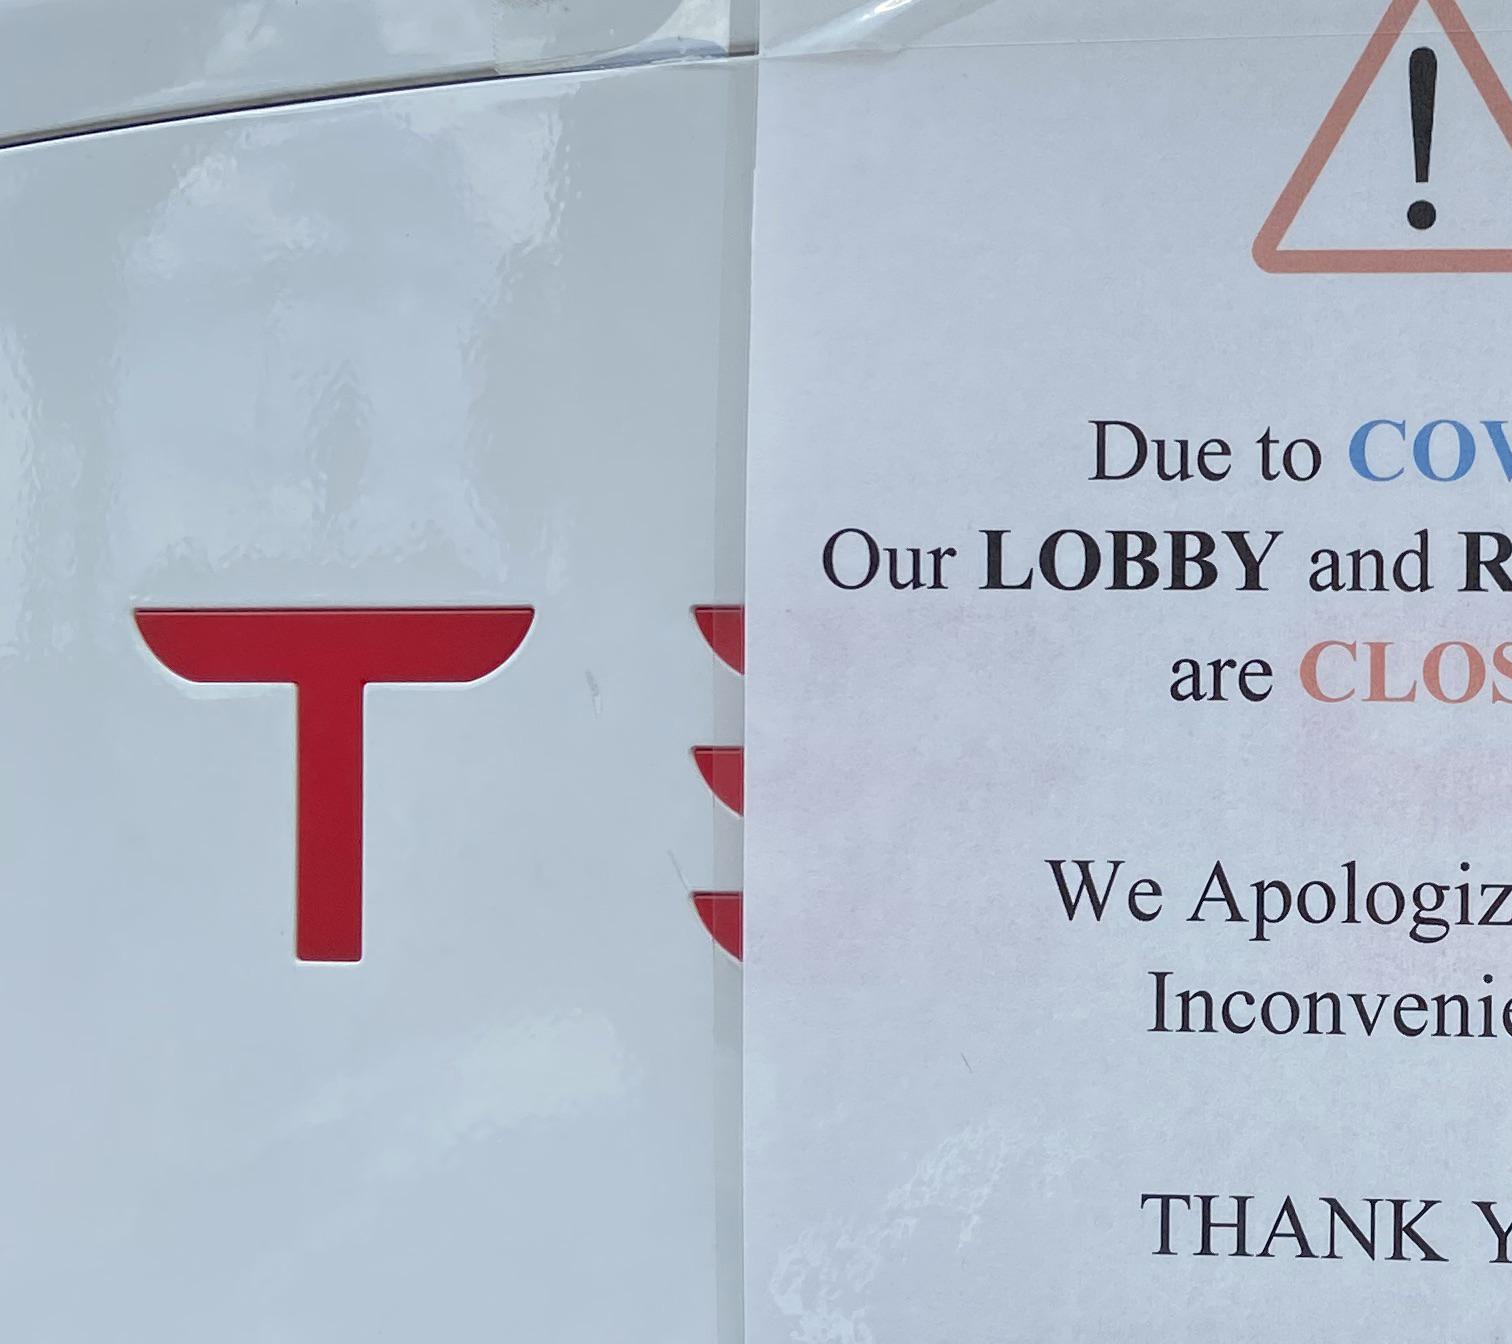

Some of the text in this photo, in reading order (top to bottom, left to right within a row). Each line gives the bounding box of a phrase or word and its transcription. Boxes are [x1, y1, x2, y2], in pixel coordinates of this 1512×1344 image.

[1087, 419, 1232, 482] Due
[1255, 425, 1322, 482] to
[822, 527, 958, 591] Our
[978, 528, 1285, 592] LOBBY
[1308, 527, 1435, 593] and
[1169, 658, 1273, 703] are
[1043, 859, 1163, 923] We
[1140, 1193, 1450, 1263] THANK
